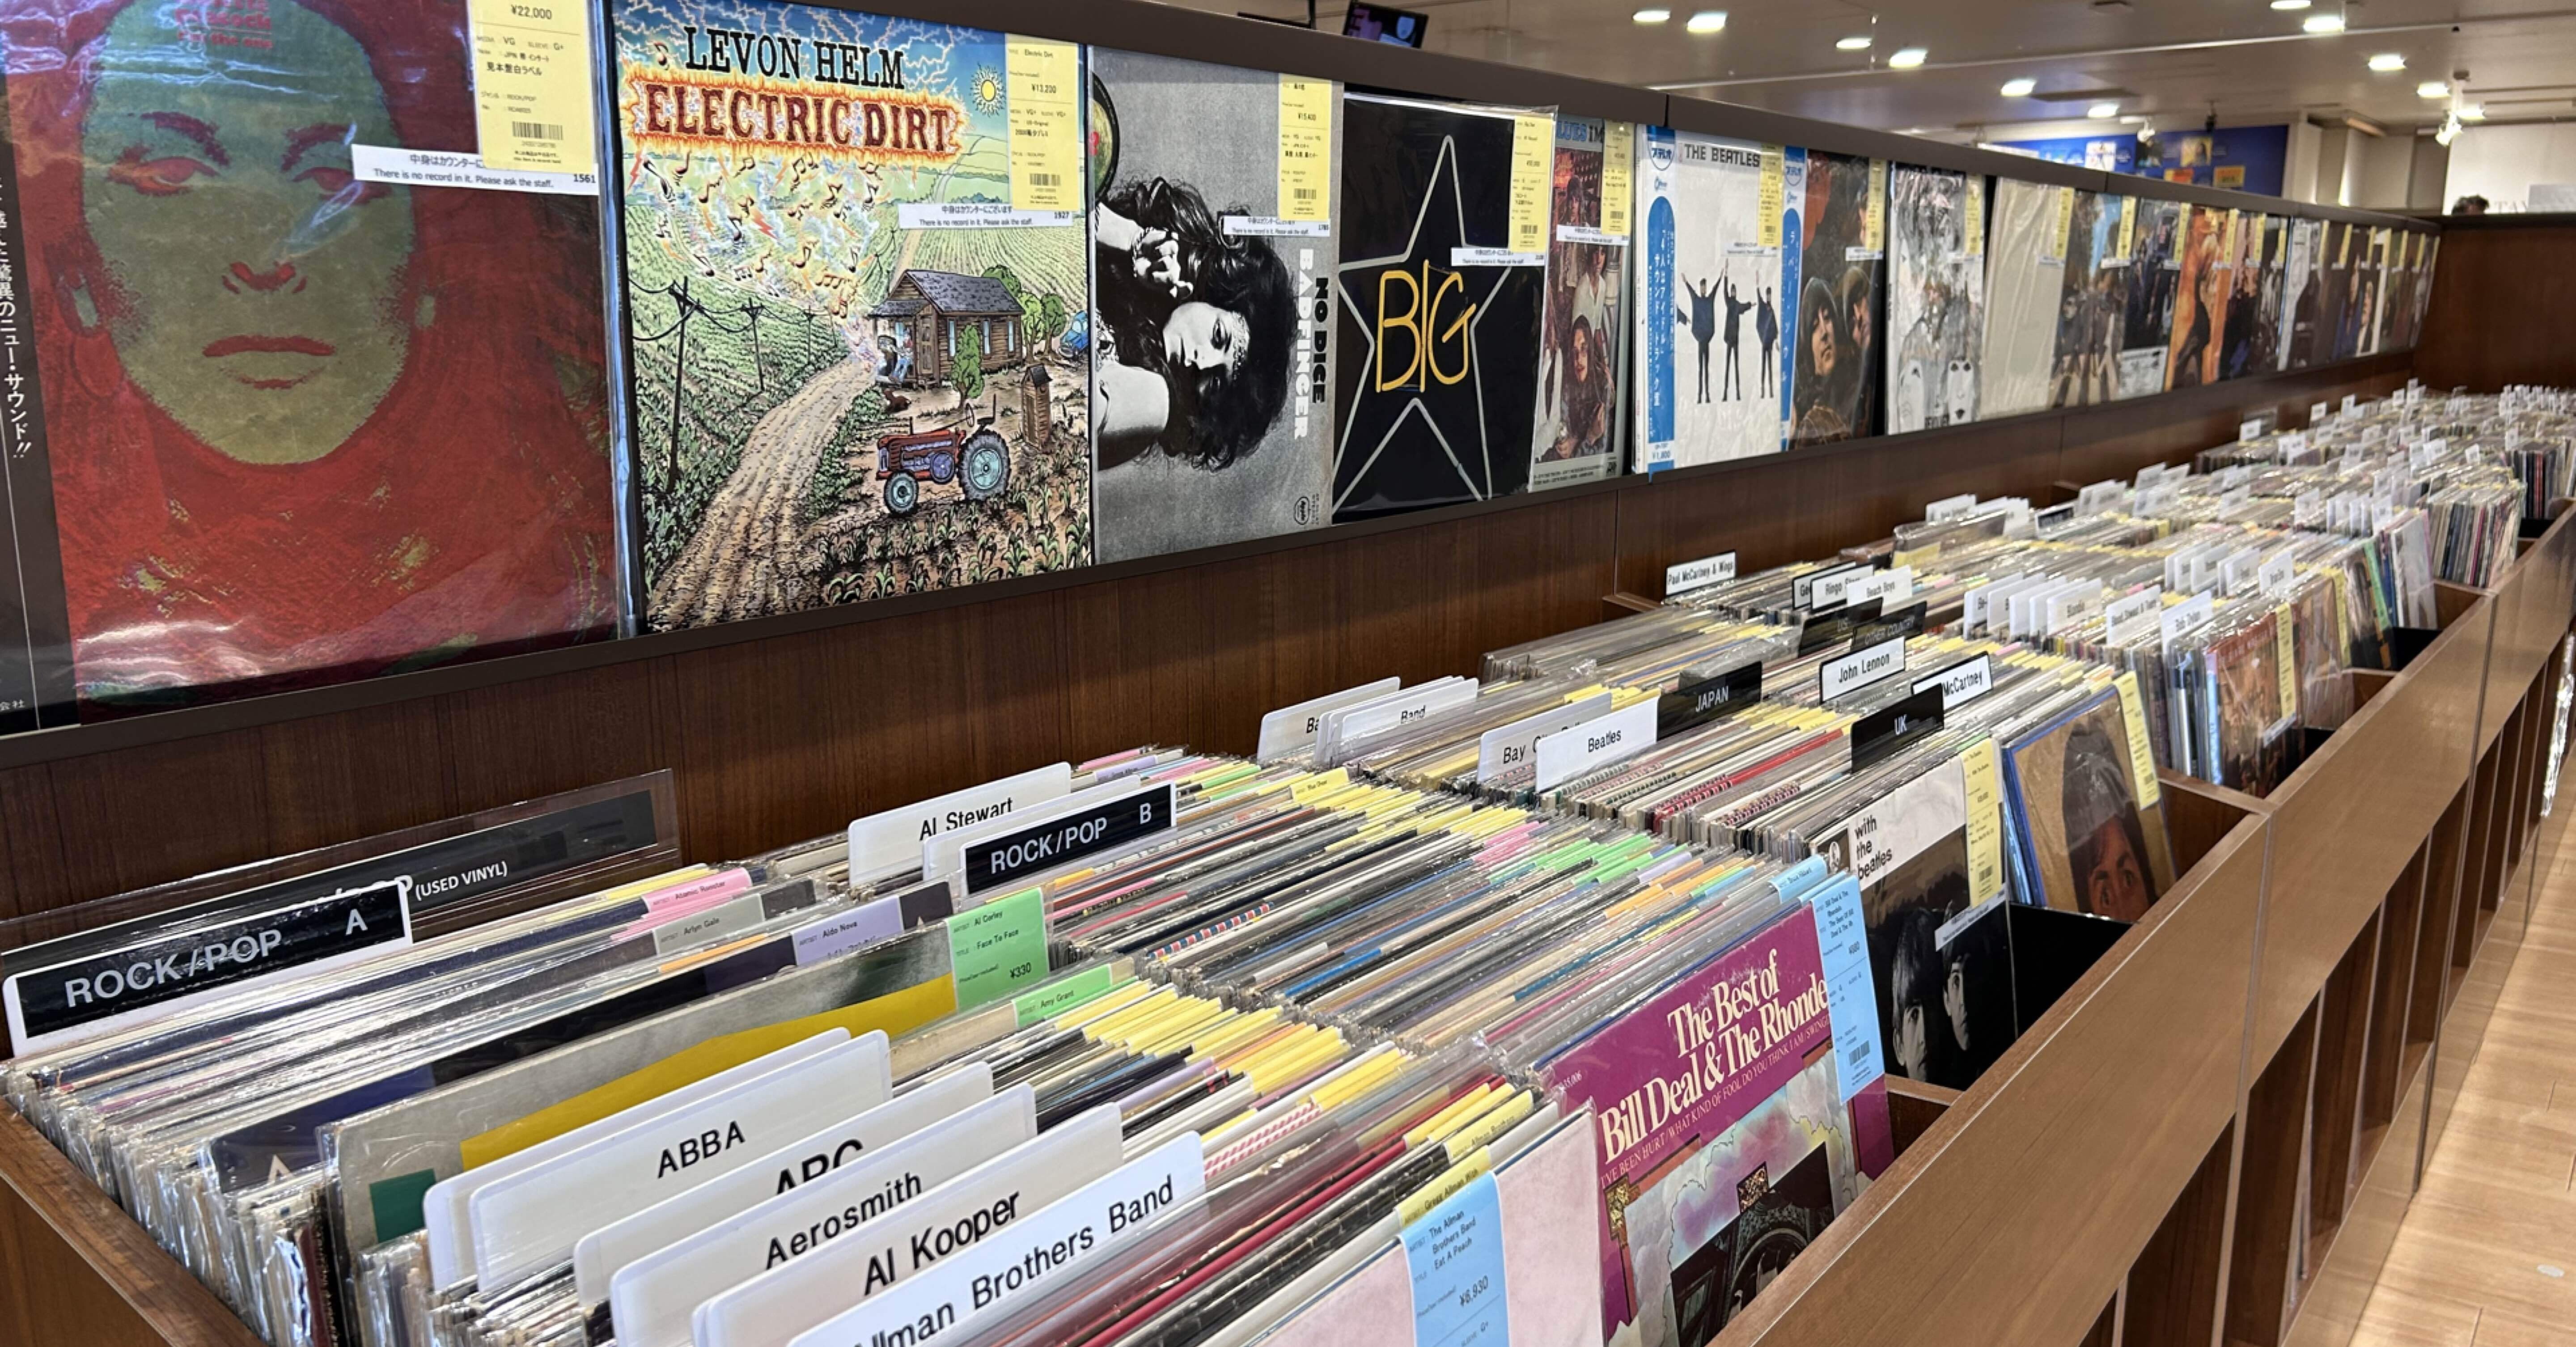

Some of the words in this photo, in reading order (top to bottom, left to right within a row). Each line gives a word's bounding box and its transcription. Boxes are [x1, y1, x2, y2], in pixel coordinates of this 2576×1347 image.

[683, 26, 802, 80] LEVON
[814, 41, 906, 89] HELM
[646, 85, 854, 147] ELECTRIC
[863, 102, 950, 152] DIRT
[1685, 144, 1706, 161] THE
[1712, 148, 1760, 167] BEATLES
[374, 168, 399, 180] There
[401, 170, 408, 180] is
[425, 171, 452, 182] record
[454, 172, 462, 182] in
[464, 173, 474, 184] it.
[475, 174, 501, 185] Please
[503, 175, 517, 186] ask
[519, 176, 532, 186] the
[534, 177, 554, 188] staff.
[573, 173, 596, 184] 1561
[983, 218, 999, 226] Please
[1000, 218, 1010, 226] ask
[1011, 218, 1019, 226] the
[1315, 278, 1329, 322] NO
[1376, 259, 1476, 393] BIG
[1295, 249, 1314, 440] BADFINGER
[1313, 330, 1328, 403] DICE
[1839, 665, 1858, 683] John
[1861, 652, 1890, 674] Lennon
[1400, 705, 1427, 724] Band
[1695, 686, 1729, 712] JAPAN
[1894, 714, 1907, 735] UK
[1503, 744, 1526, 764] Bay
[1588, 729, 1622, 753] Beatles
[946, 797, 1013, 831] Stewart
[1855, 815, 1877, 839] with
[991, 817, 1108, 874] ROCK/POP
[1140, 803, 1152, 824] B
[1856, 839, 1872, 860] the
[1857, 848, 1892, 880] beatles
[415, 875, 459, 901] (USED
[461, 860, 508, 885] VINYL)
[822, 928, 839, 938] Aldo
[839, 921, 858, 932] Nova
[974, 917, 982, 927] Al
[976, 938, 992, 949] Face
[993, 934, 1003, 944] To
[1004, 929, 1019, 939] Face
[65, 930, 283, 1008] ROCK/POP
[345, 909, 369, 936] A
[1009, 962, 1032, 979] ¥330
[1040, 999, 1055, 1009] Amy
[1667, 1003, 1715, 1058] The
[1711, 971, 1759, 1031] Best
[1760, 949, 1780, 999] of
[1598, 1093, 1648, 1165] Bill
[1646, 1052, 1701, 1134] Deal
[1703, 1042, 1724, 1091] &
[1718, 1022, 1761, 1079] The
[1600, 1171, 1618, 1190] I'VE
[1619, 1152, 1642, 1175] BEEN
[1691, 1101, 1712, 1122] KIND
[1712, 1093, 1722, 1106] OF
[1722, 1080, 1742, 1100] FOOL
[1742, 1072, 1754, 1087] DO
[1752, 1061, 1768, 1079] YOU
[1767, 1042, 1790, 1065] THINK
[657, 1120, 746, 1179] ABBA
[765, 1171, 922, 1271] Aerosmith
[1429, 1224, 1442, 1238] The
[1444, 1210, 1465, 1231] Allman
[1432, 1229, 1459, 1254] Brothers
[1460, 1216, 1476, 1234] Band
[864, 1248, 895, 1296] Al
[910, 1191, 1021, 1270] Kooper
[1433, 1257, 1446, 1270] Eat
[1447, 1250, 1453, 1260] A
[1453, 1237, 1473, 1256] Peach
[855, 1302, 955, 1347] llman
[971, 1225, 1095, 1310] Brothers
[1108, 1174, 1174, 1234] Band
